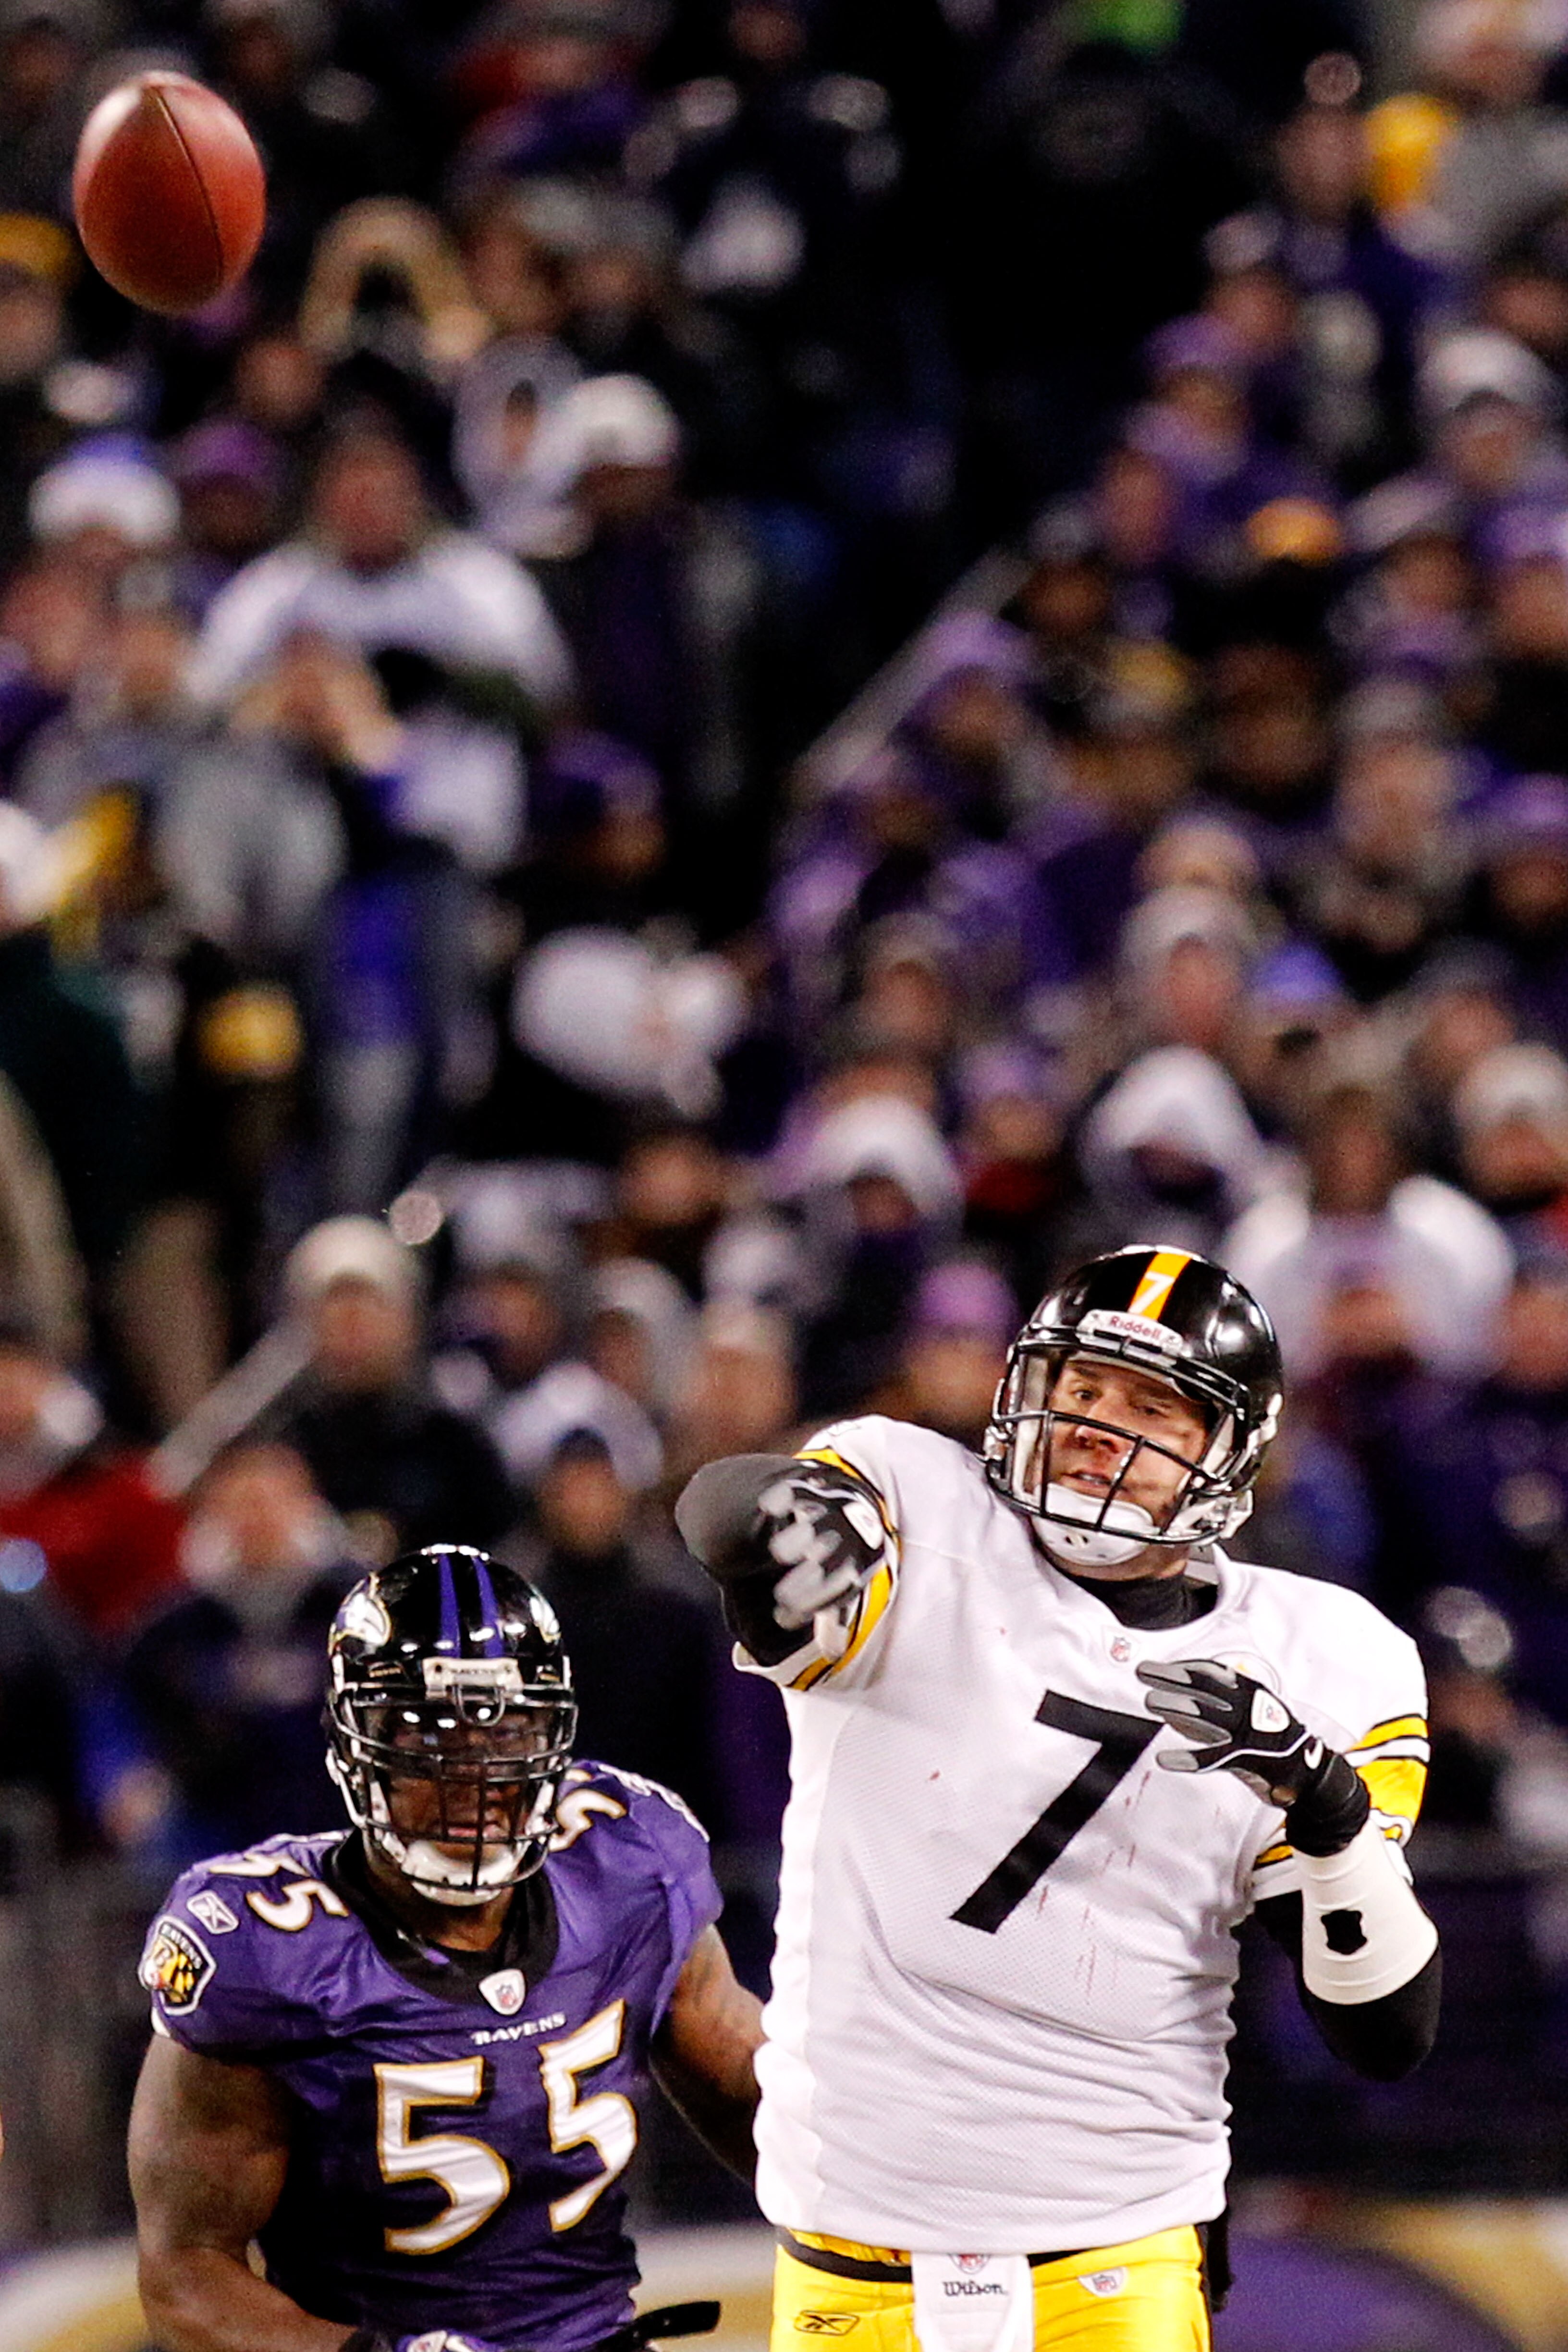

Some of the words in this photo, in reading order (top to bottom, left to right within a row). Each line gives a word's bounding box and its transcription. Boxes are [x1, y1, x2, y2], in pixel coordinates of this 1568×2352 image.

[1128, 1271, 1176, 1314] 7
[1111, 1315, 1163, 1339] Riddell
[949, 1689, 1166, 1935] 7
[470, 2011, 566, 2046] RAVENS
[373, 1998, 639, 2256] 55
[942, 2279, 1009, 2297] Wilson
